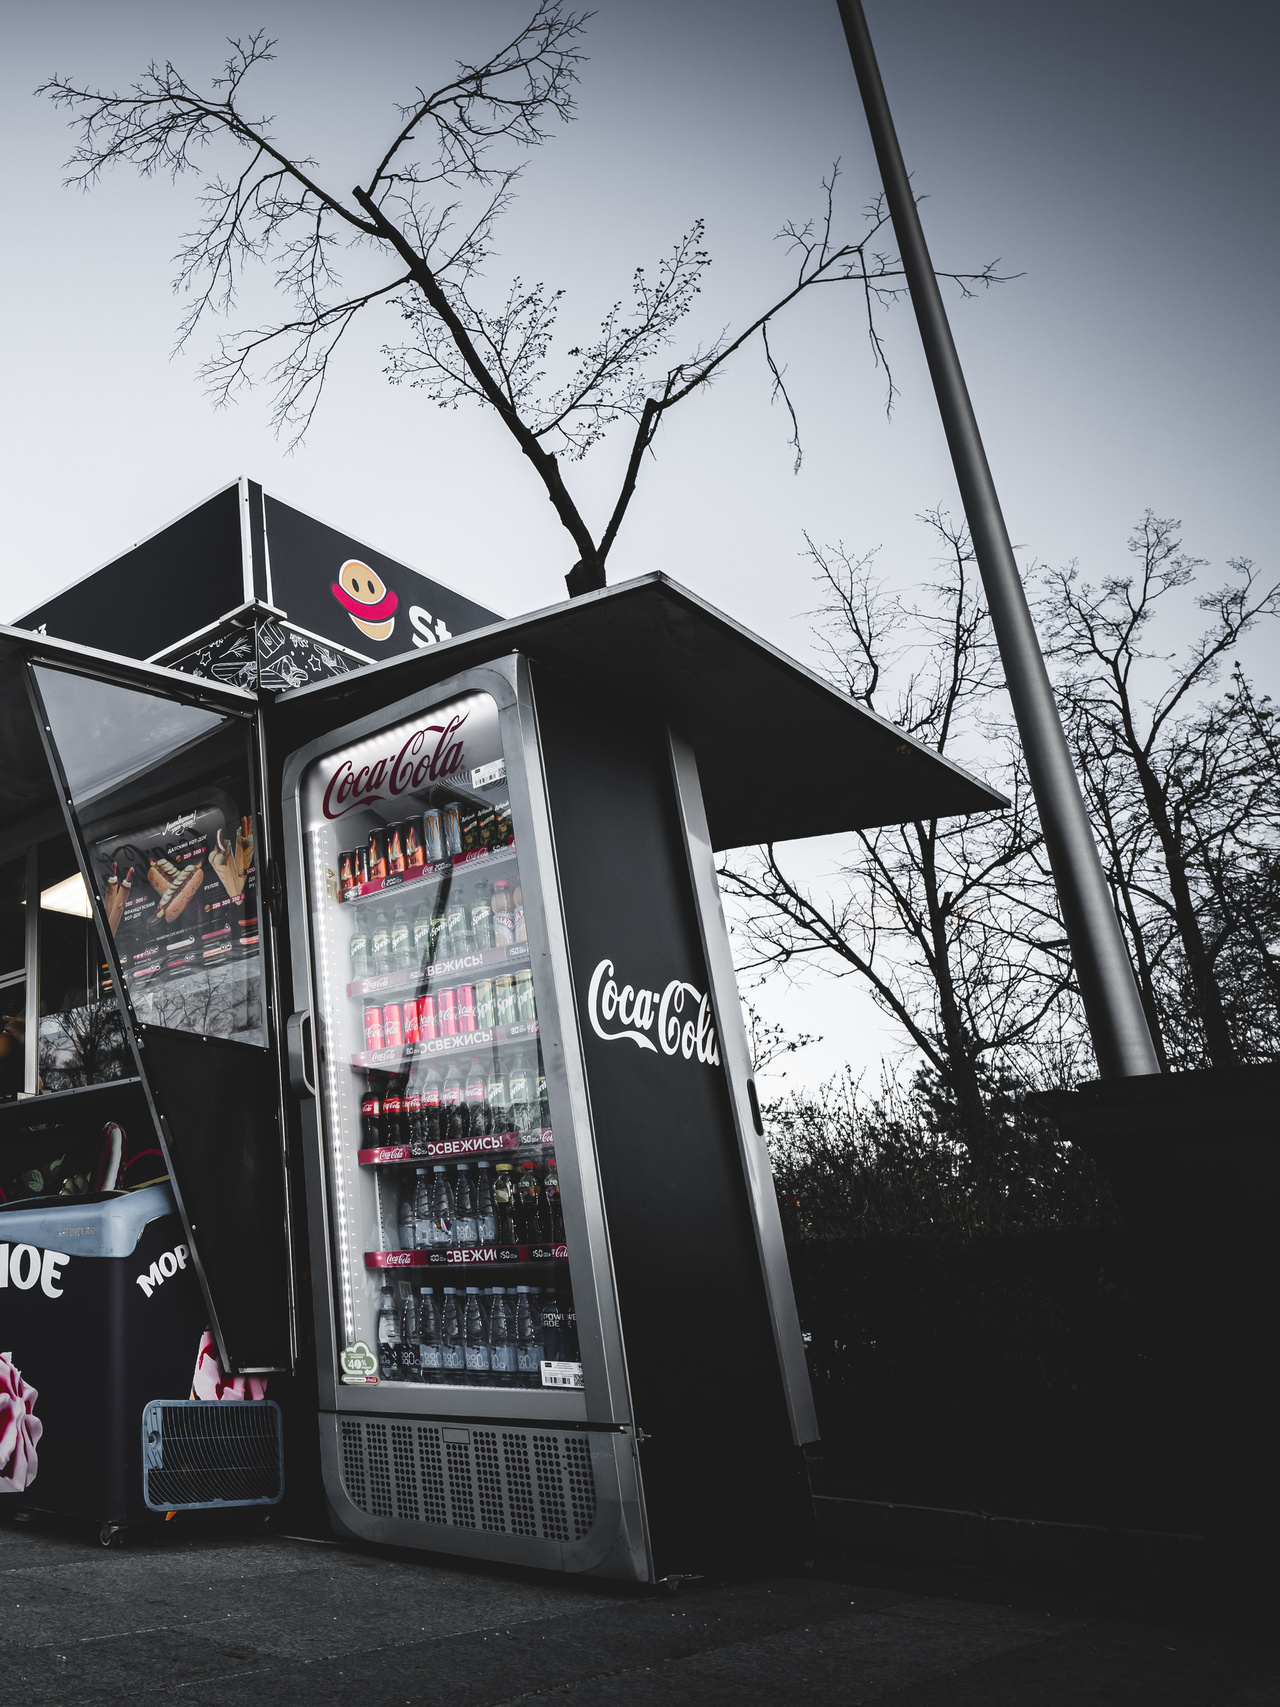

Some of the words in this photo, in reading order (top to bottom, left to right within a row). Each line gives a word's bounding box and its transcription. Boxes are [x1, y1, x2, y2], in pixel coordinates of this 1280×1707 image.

[322, 710, 471, 820] Coca-Cola
[426, 954, 484, 978] ВЕЖИСЬ!
[588, 959, 720, 1067] Coca-Cola
[379, 1147, 404, 1161] Coca-Cola
[386, 1252, 411, 1265] Coca-Cola
[543, 1313, 566, 1321] POWE
